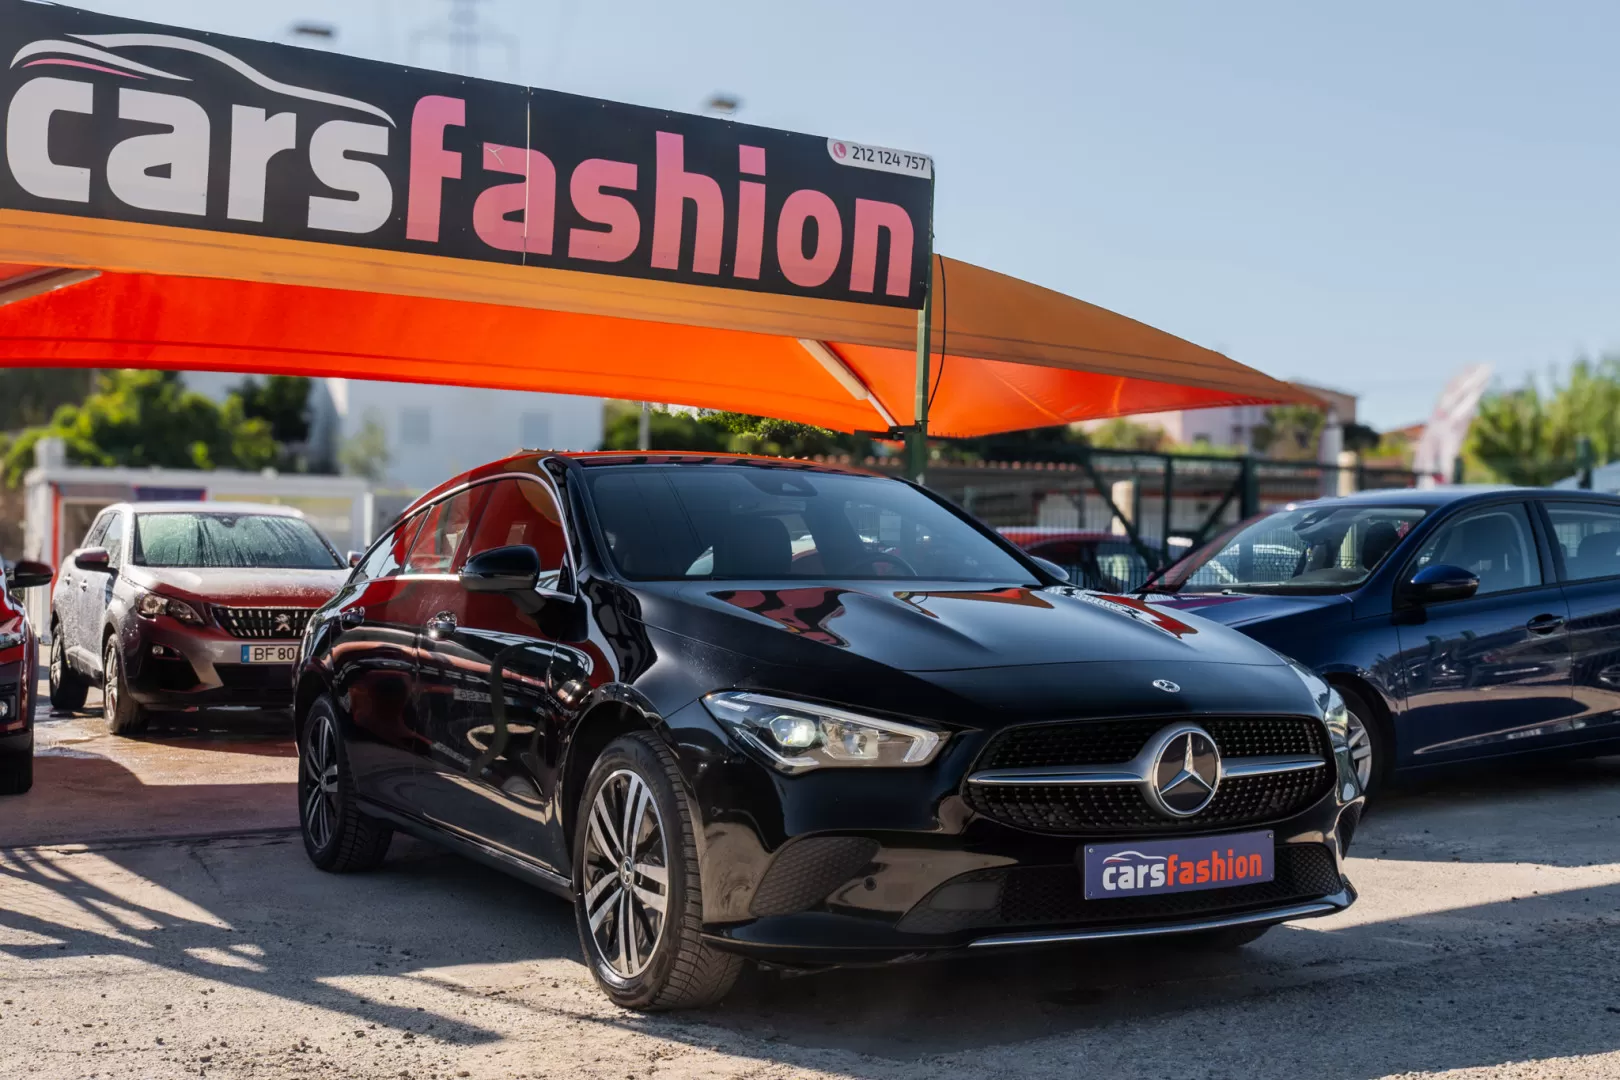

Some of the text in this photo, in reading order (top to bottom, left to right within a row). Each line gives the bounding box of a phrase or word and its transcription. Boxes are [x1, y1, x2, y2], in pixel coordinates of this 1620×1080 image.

[852, 146, 926, 171] 212 124 757
[254, 647, 295, 661] BF 80
